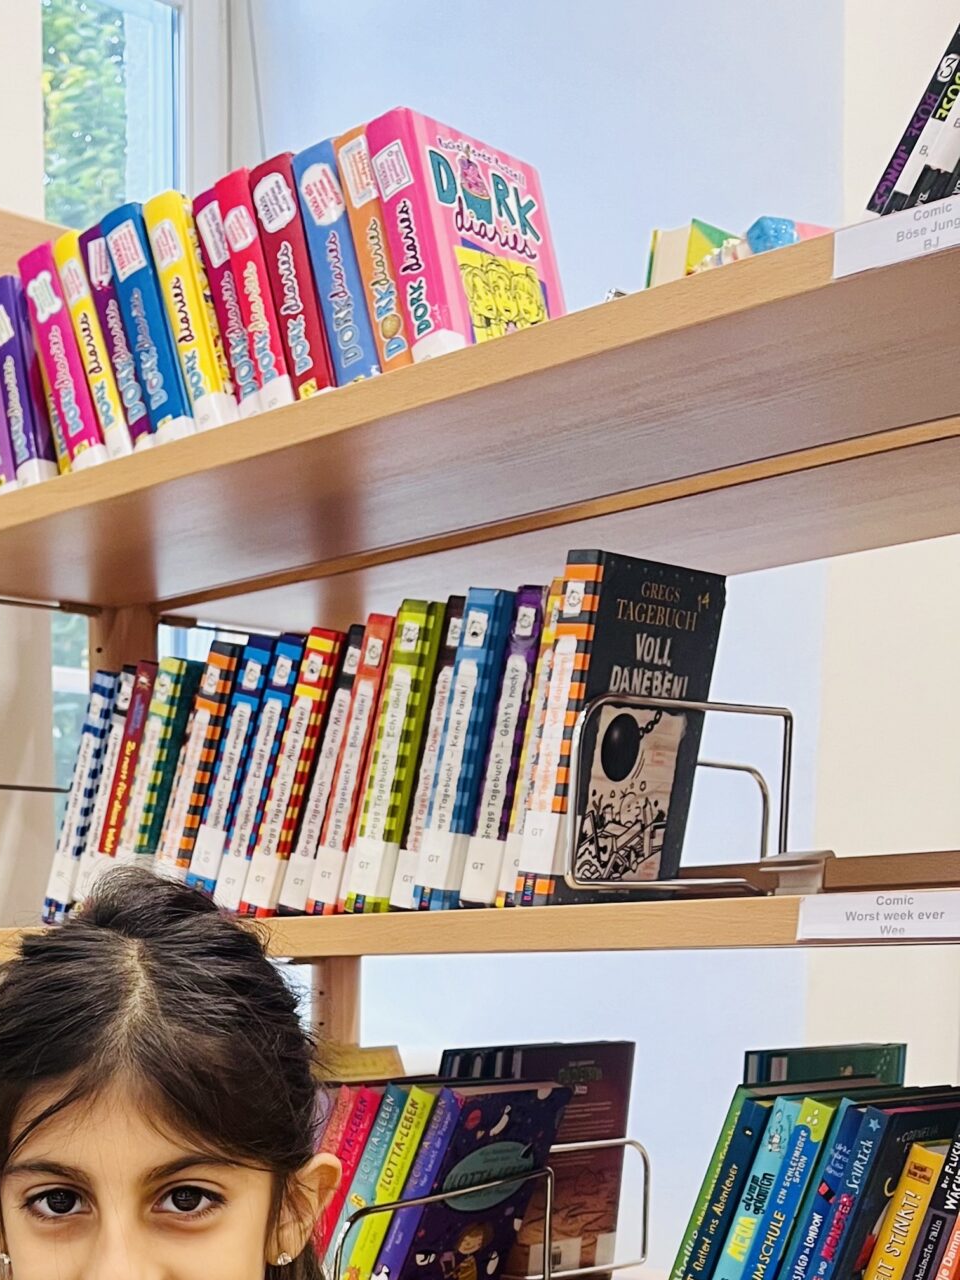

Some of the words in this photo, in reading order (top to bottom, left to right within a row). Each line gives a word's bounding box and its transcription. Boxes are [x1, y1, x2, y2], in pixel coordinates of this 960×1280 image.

[939, 57, 957, 79] 3
[455, 197, 537, 260] diaries
[913, 203, 953, 222] Comic
[397, 198, 422, 275] diaries
[896, 226, 928, 243] Böse
[924, 236, 940, 251] BJ
[325, 231, 348, 302] diaries
[366, 217, 390, 289] diaries
[277, 241, 303, 315] diaries
[173, 276, 194, 344] diaries
[407, 278, 434, 338] DORK
[79, 312, 103, 375] diaries
[288, 314, 313, 376] DORK
[333, 295, 363, 367] DORK
[184, 349, 205, 400] DORK
[254, 331, 278, 384] DORK
[94, 378, 115, 430] DORK
[641, 581, 681, 602] GREGS
[616, 598, 698, 632] TAGEBUCH
[635, 633, 672, 667] VOLL
[507, 667, 519, 697] noch?
[608, 665, 689, 699] DANEBEN!
[455, 684, 468, 715] Panik!
[449, 719, 462, 747] Keine
[263, 827, 277, 856] Gregs
[286, 737, 298, 761] Alles
[300, 828, 315, 857] Gregs
[328, 728, 338, 743] ein
[328, 818, 342, 848] Gregs
[531, 828, 544, 837] GT
[321, 870, 333, 880] GT
[359, 861, 370, 870] GT
[428, 855, 440, 864] GT
[472, 862, 484, 871] GT
[293, 877, 305, 886] GT
[402, 875, 414, 884] GT
[845, 911, 879, 922] Worst
[883, 910, 914, 921] week
[918, 911, 945, 920] ever
[876, 895, 914, 906] Comic
[880, 925, 905, 935] Wee
[793, 1155, 807, 1183] SPION
[713, 1164, 738, 1215] Abenteuer
[777, 1188, 787, 1204] EIN
[709, 1217, 719, 1235] ins
[808, 1213, 822, 1248] LONDON
[821, 1193, 854, 1261] MONSTER
[885, 1189, 924, 1257] STINKT!
[943, 1230, 960, 1266] Damm
